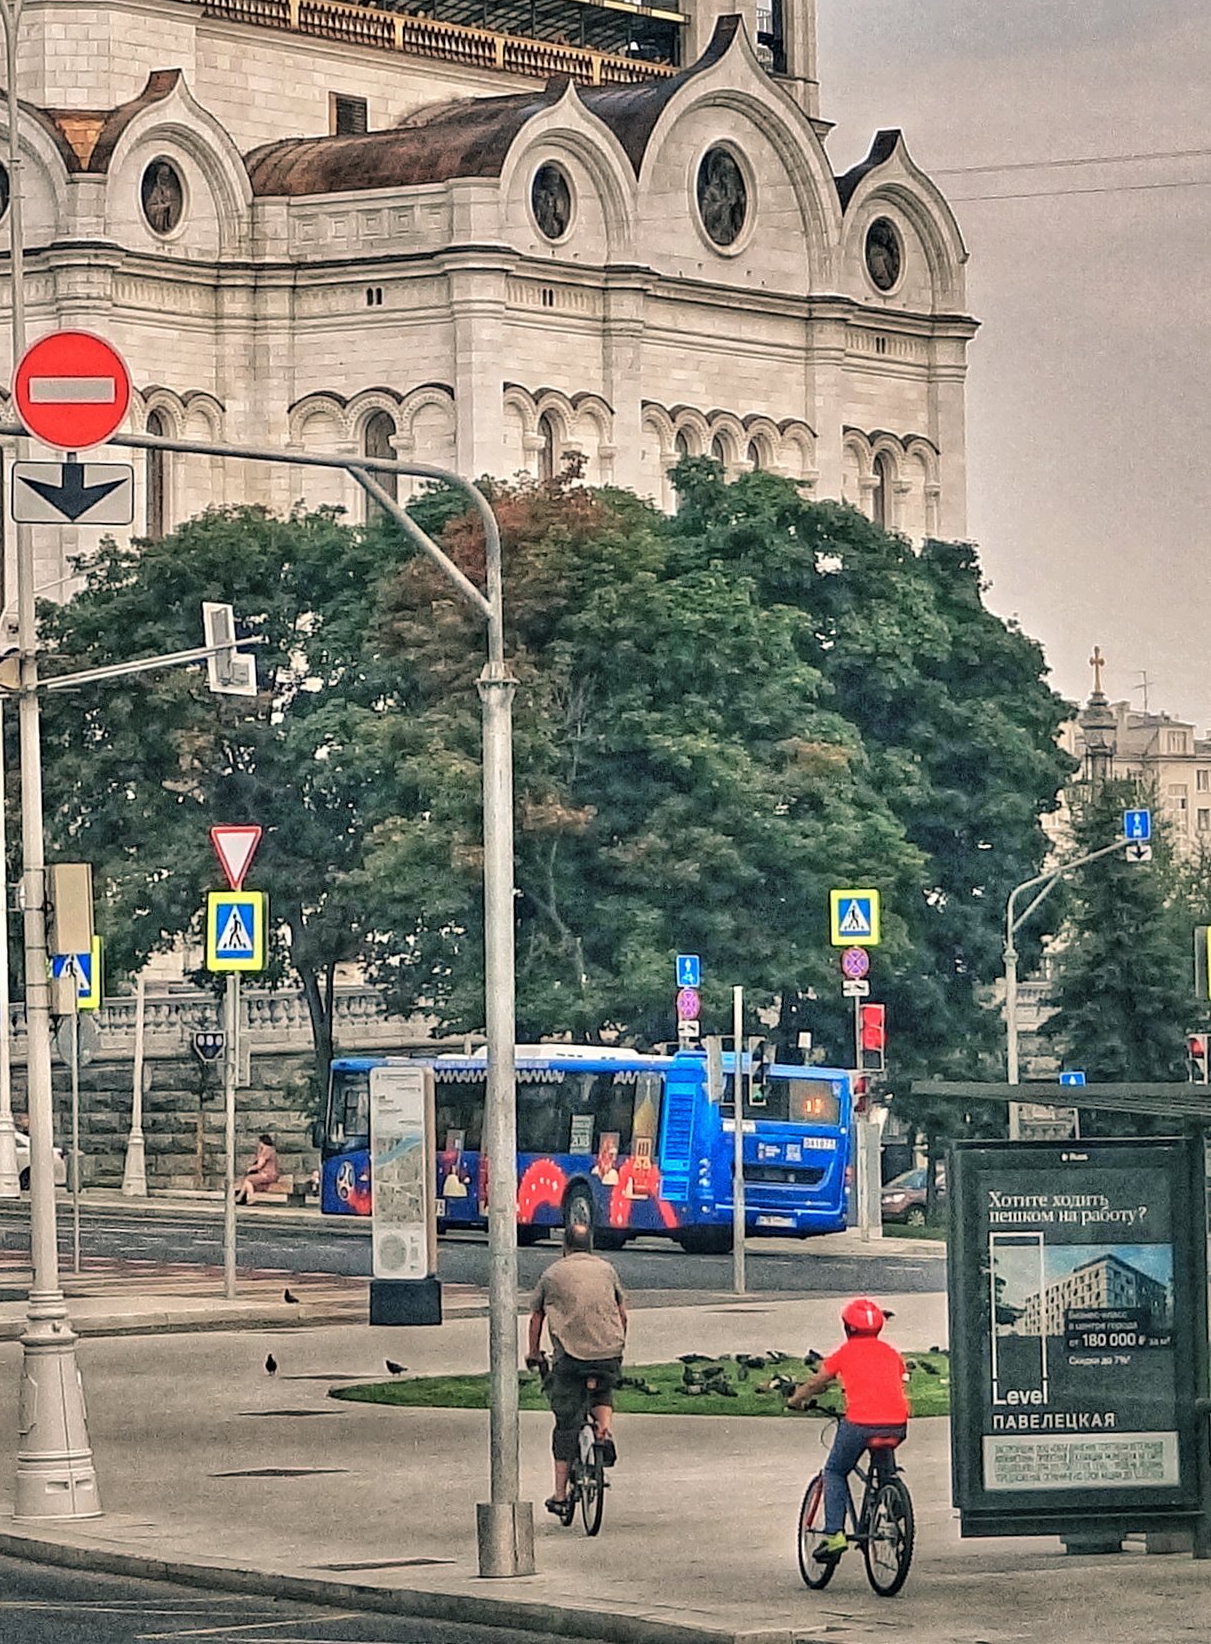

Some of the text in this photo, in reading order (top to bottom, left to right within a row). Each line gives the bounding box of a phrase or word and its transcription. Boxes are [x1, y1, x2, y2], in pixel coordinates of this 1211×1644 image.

[988, 1190, 1109, 1209] Хотите ходить
[989, 1206, 1148, 1226] пешком на работу?
[1082, 1333, 1107, 1347] 180
[1109, 1332, 1136, 1347] 000
[992, 1380, 1049, 1405] Level
[992, 1412, 1116, 1430] ПАВЕЛЕЦКАЯ
